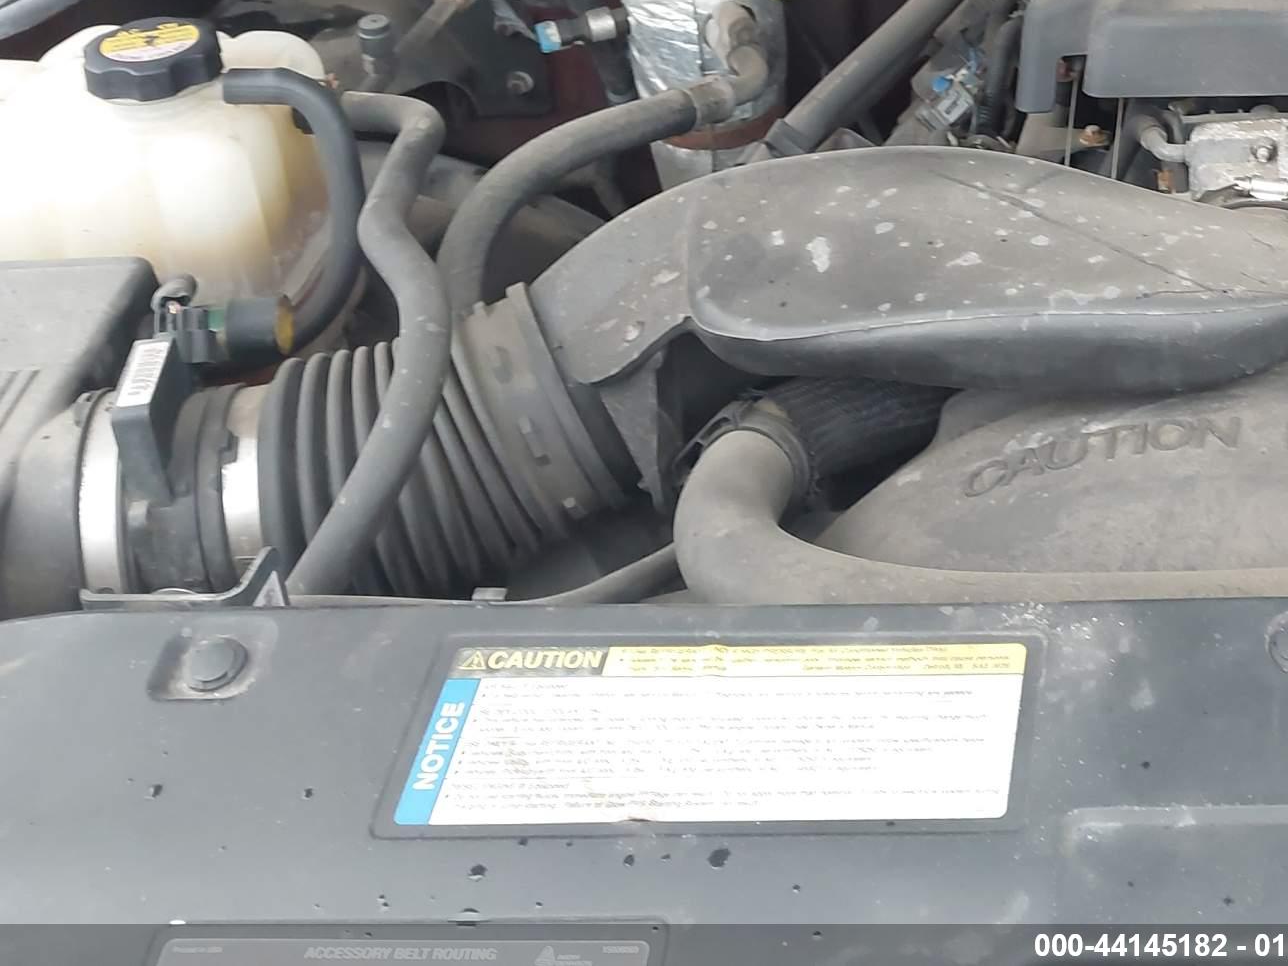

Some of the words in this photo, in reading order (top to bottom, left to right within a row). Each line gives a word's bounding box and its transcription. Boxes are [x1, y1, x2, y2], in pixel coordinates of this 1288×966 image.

[964, 417, 1241, 497] CAUTION
[486, 650, 603, 670] CAUTION
[412, 701, 465, 791] NOTICE
[304, 946, 392, 960] ACCESSORY
[393, 947, 431, 960] BELT
[432, 947, 498, 960] ROUTING
